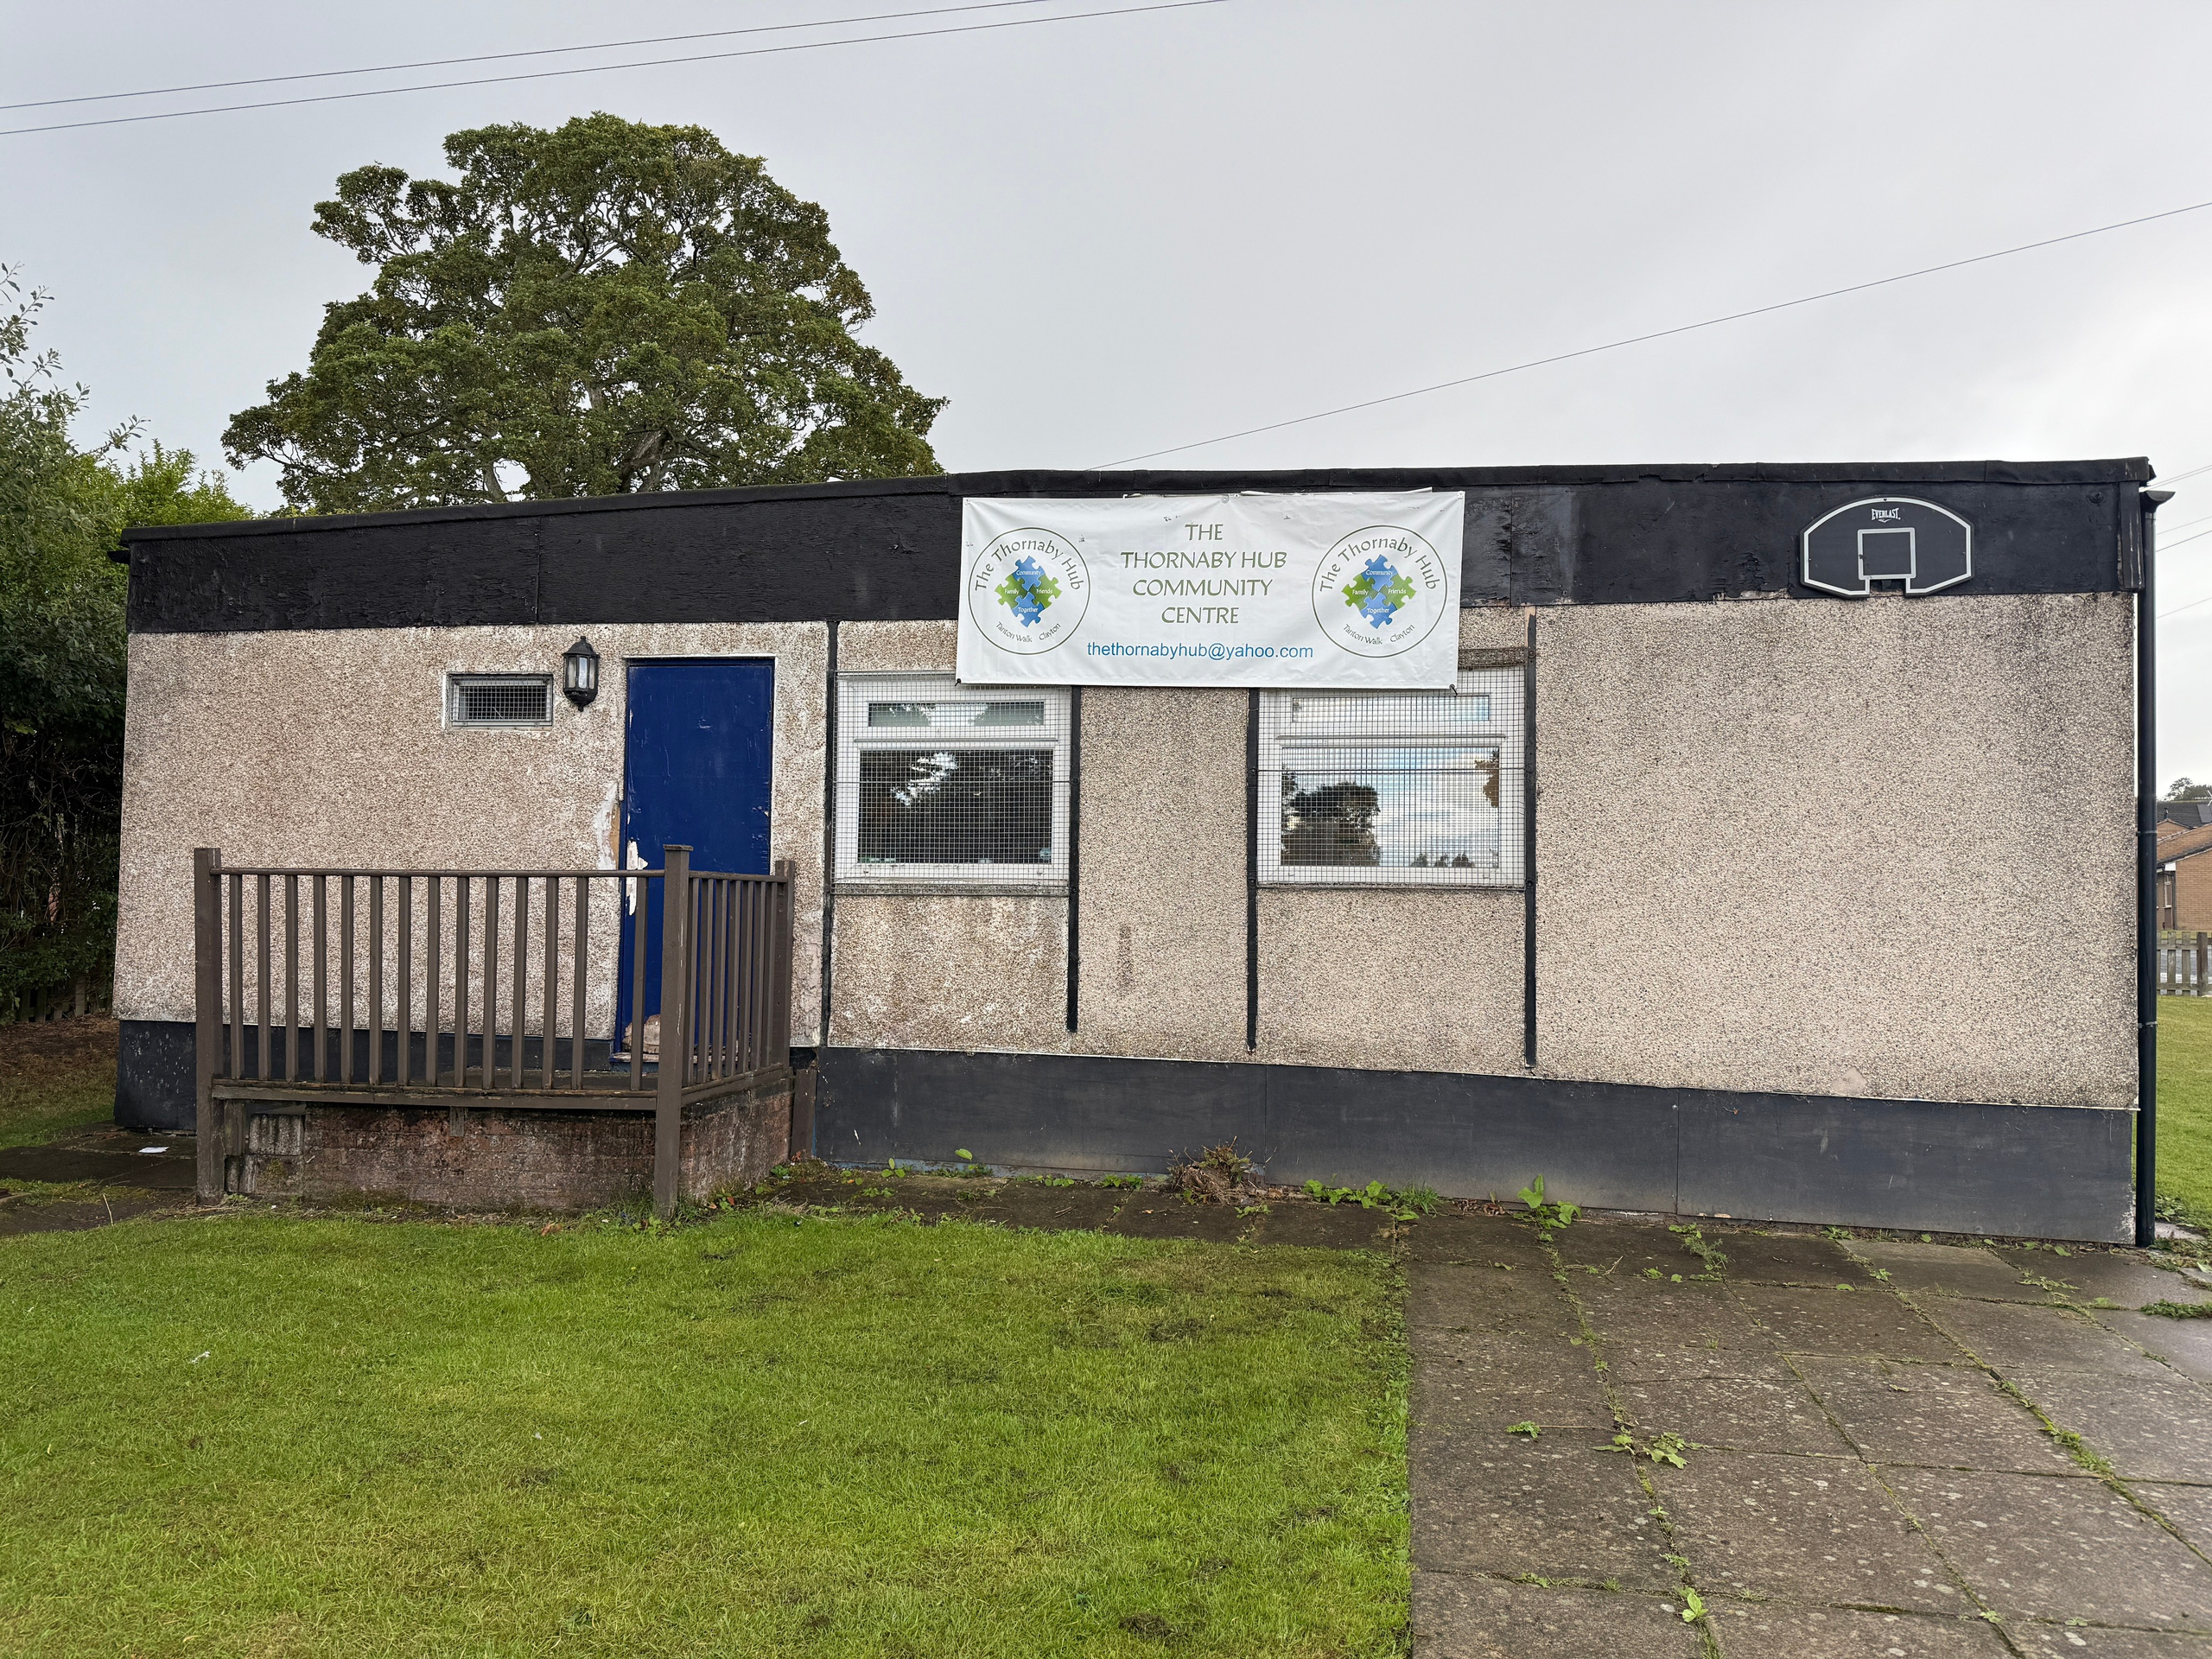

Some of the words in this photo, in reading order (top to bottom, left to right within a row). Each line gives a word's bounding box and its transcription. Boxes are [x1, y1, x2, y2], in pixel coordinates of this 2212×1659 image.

[1872, 507, 1899, 520] EVERLAST
[1185, 524, 1224, 541] THE
[975, 563, 995, 591] The
[991, 540, 1064, 562] Thornaby
[1061, 557, 1084, 590] Hub
[1121, 551, 1236, 569] THORNABY
[1241, 551, 1287, 569] HUB
[1319, 563, 1341, 592] The
[1338, 537, 1417, 562] Thornaby
[1415, 555, 1440, 589] Hub
[1133, 579, 1273, 596] COMMUNITY
[1161, 607, 1239, 624] CENTRE
[995, 621, 1014, 639] Tanton
[1039, 623, 1061, 640] Clayton
[1343, 624, 1363, 642] Tanton
[1389, 624, 1415, 643] Clayton
[1087, 642, 1313, 661] thethornabyhub@yahoo.com
